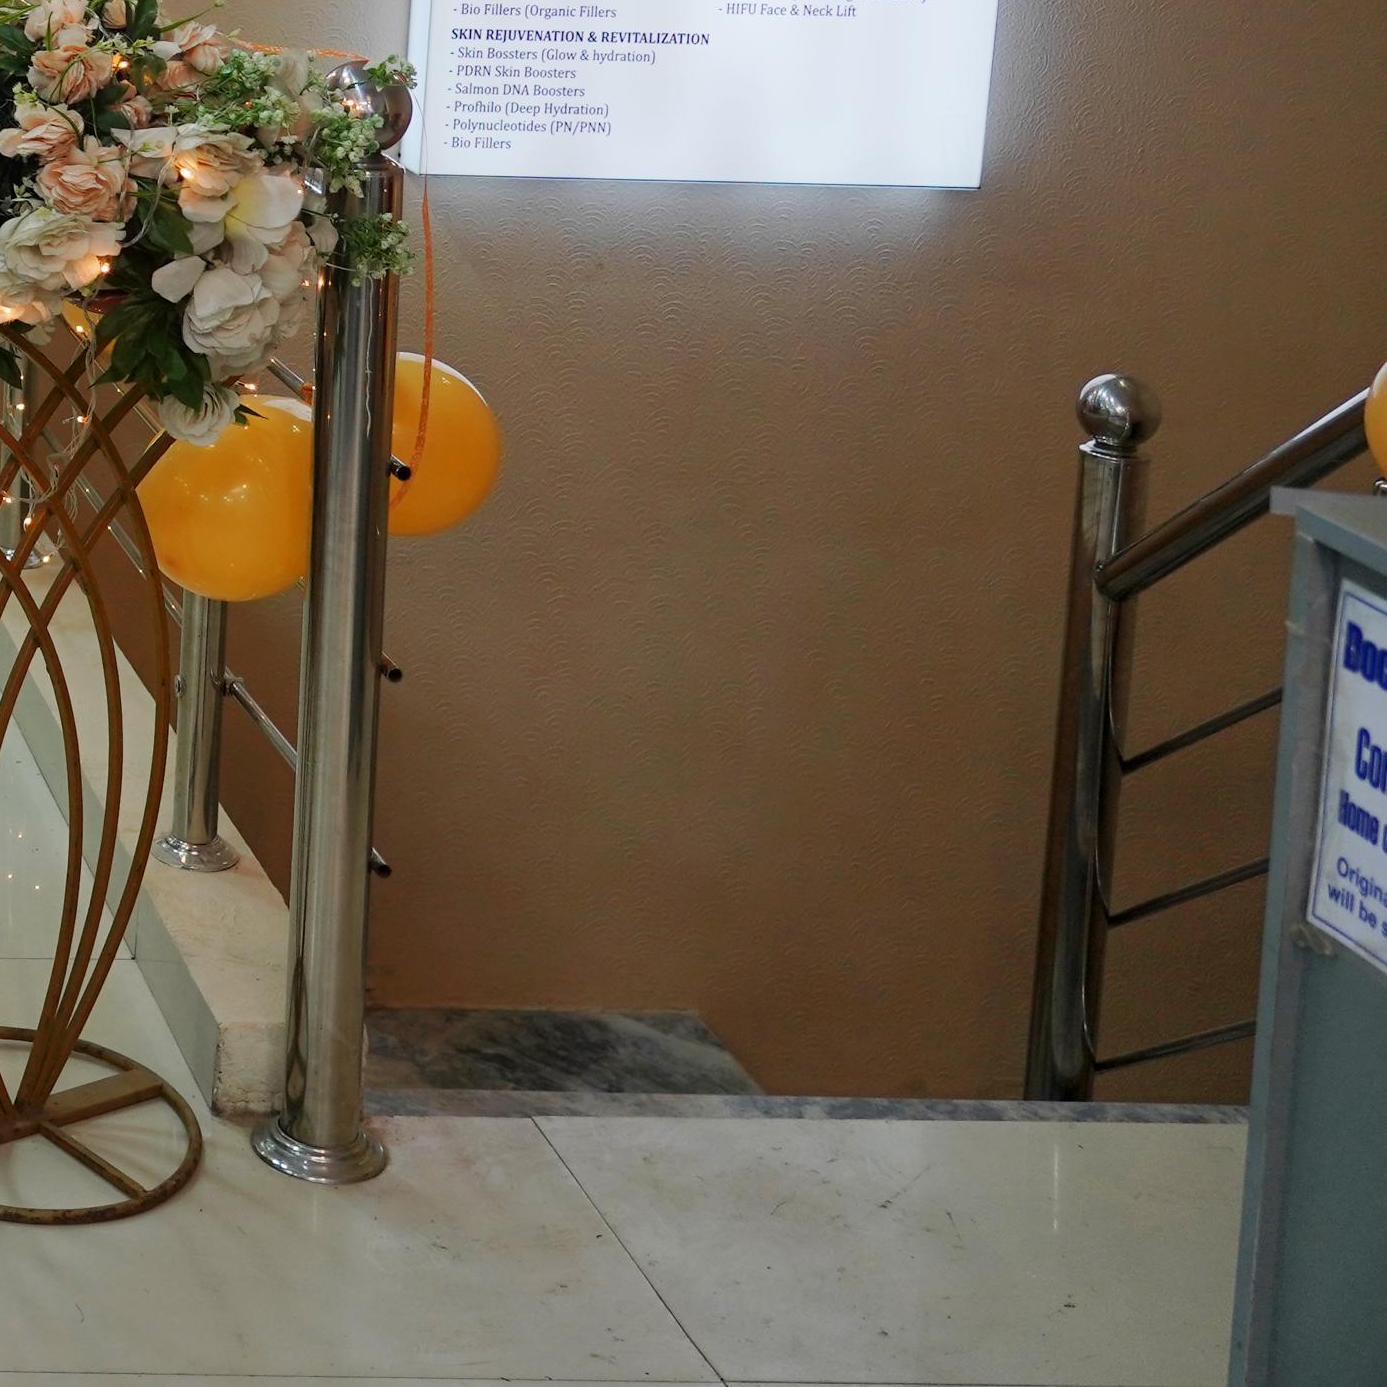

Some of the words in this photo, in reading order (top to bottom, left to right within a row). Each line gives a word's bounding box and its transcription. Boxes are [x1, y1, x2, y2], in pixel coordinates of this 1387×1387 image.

[451, 28, 482, 40] SKIN
[485, 28, 584, 43] REJUVENATION
[587, 31, 597, 43] &
[601, 31, 709, 45] REVITALIZATION
[456, 64, 492, 77] PDRN
[494, 64, 520, 77] Skin
[524, 66, 576, 79] Boosters
[454, 100, 502, 113] Profhilo
[504, 101, 541, 117] (Deep
[544, 102, 609, 118] Hydration)
[1327, 884, 1355, 913] will
[1359, 900, 1377, 929] be
